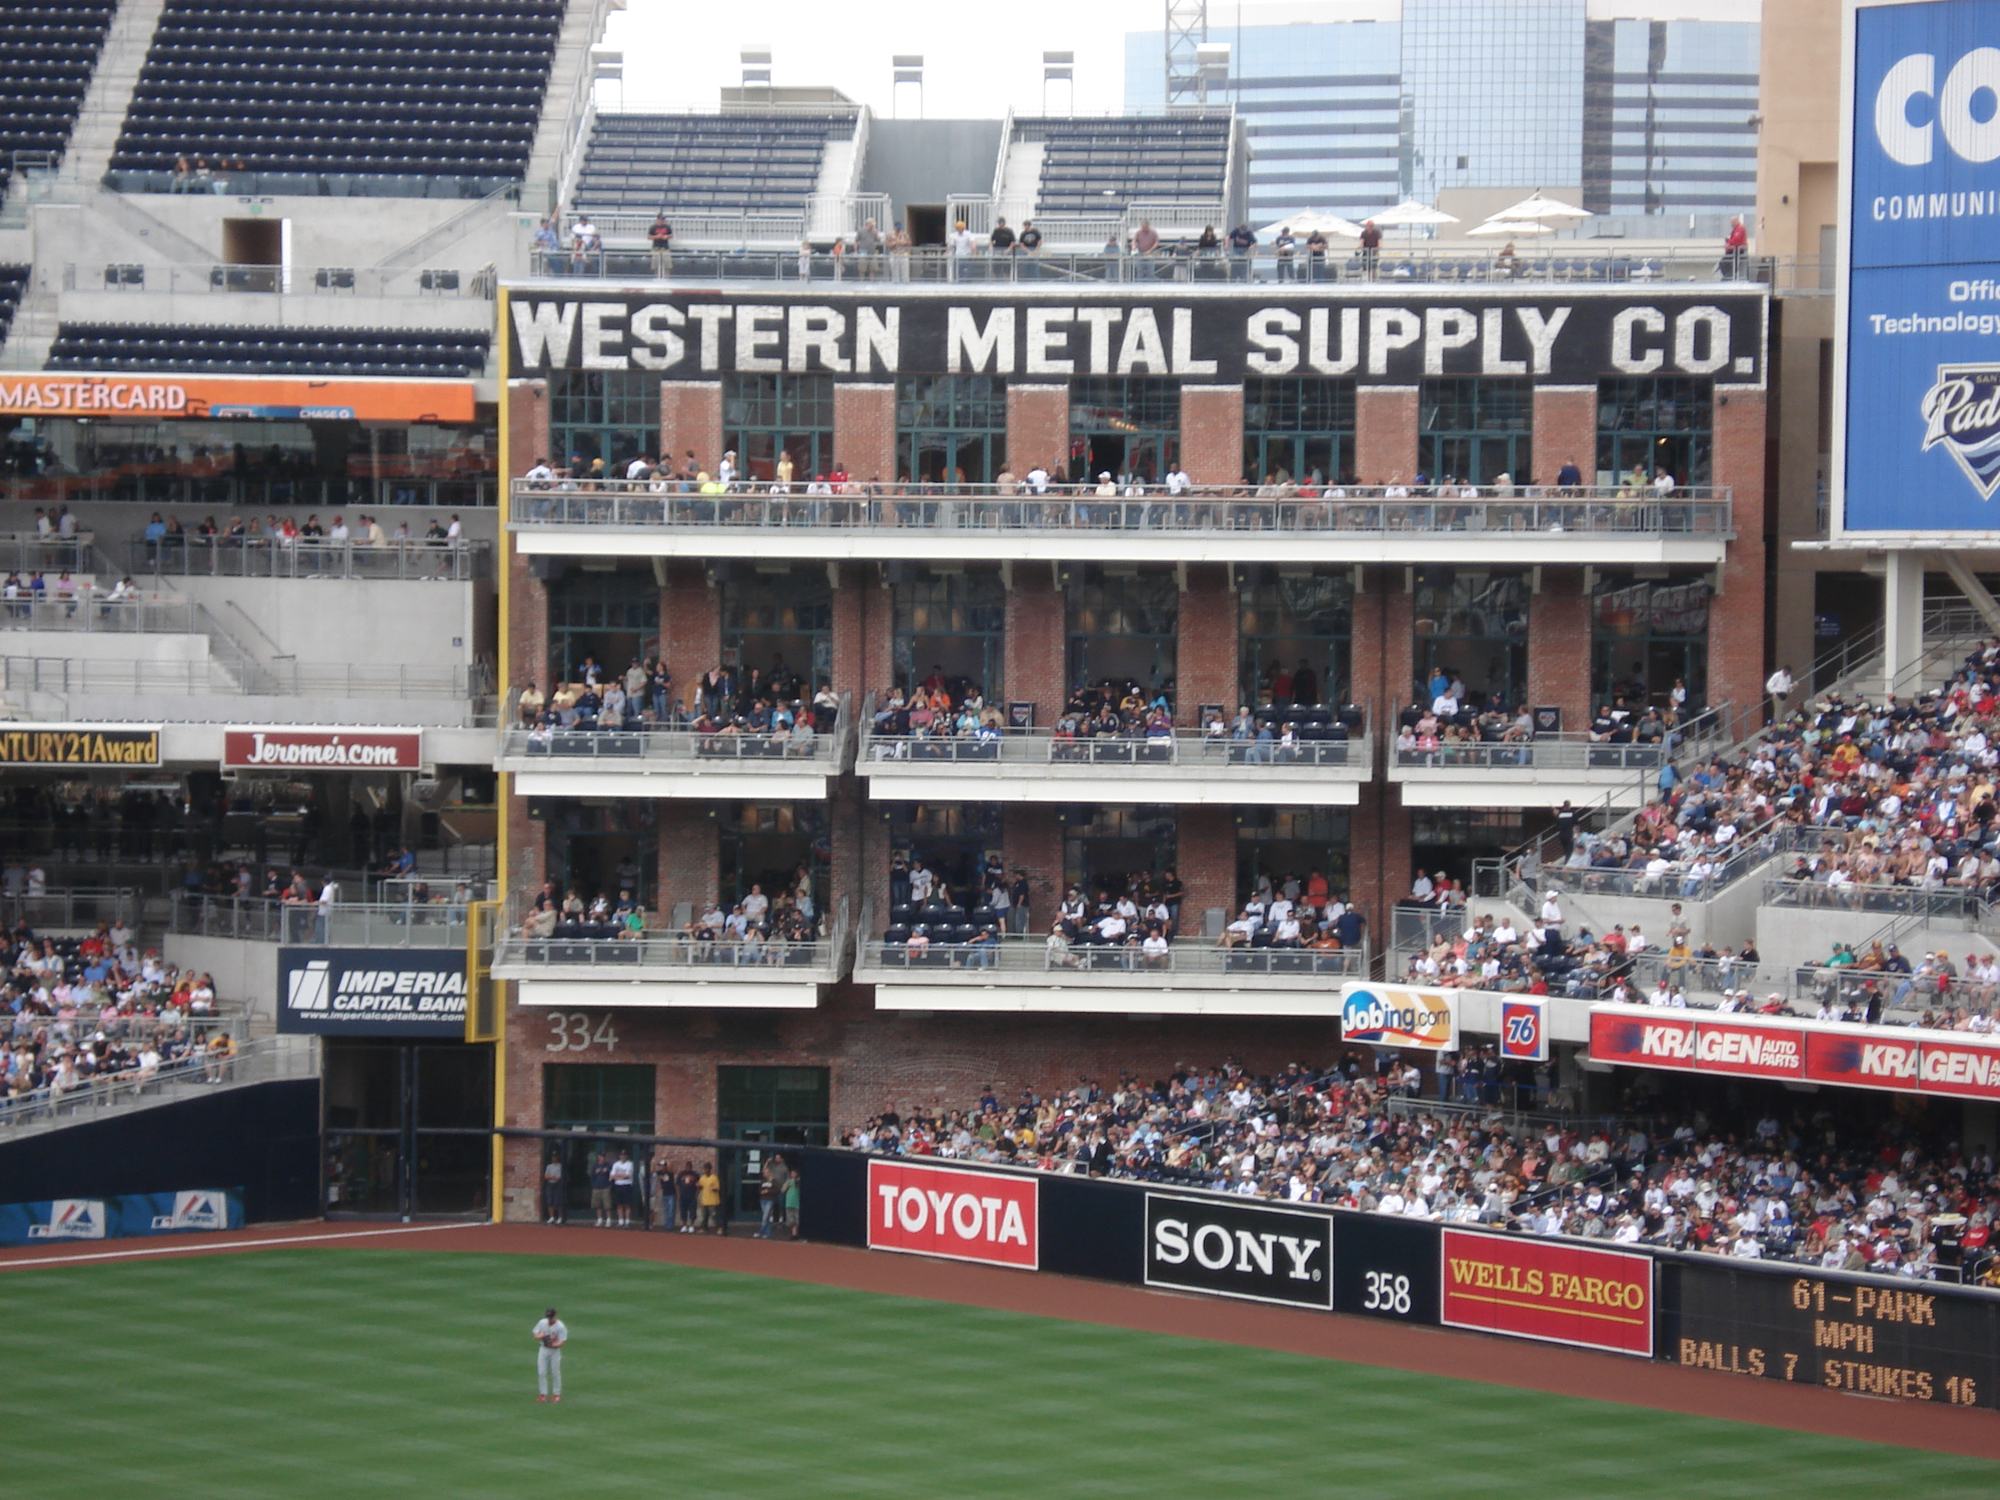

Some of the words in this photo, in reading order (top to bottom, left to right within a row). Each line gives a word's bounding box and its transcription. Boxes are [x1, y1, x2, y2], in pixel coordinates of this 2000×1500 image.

[1873, 190, 2000, 221] COMMUNI
[510, 301, 900, 373] WESTERN
[948, 307, 1217, 374] METAL
[1247, 307, 1572, 375] SUPPLY
[1611, 306, 1754, 374] CO.
[0, 383, 187, 410] MASTERCARD
[247, 733, 399, 765] Jerome's.com
[337, 971, 467, 994] IMPERIA
[333, 995, 413, 1010] CAPITAL
[1343, 1001, 1451, 1033] Jobing.com
[545, 1012, 619, 1052] 334
[1507, 1014, 1536, 1045] 76
[1641, 1026, 1763, 1065] KRAGEN
[1762, 1039, 1797, 1054] AUTO
[1759, 1052, 1800, 1068] PARTS
[1860, 1044, 1991, 1086] KRAGEN
[879, 1185, 1028, 1246] TOYOTA
[1363, 1271, 1411, 1314] 358
[1449, 1258, 1545, 1296] WELLS
[1550, 1272, 1645, 1310] FARGO
[1815, 1319, 1874, 1353] MPH
[1680, 1338, 1766, 1377] BALLS
[1784, 1353, 1799, 1381] 7
[1824, 1360, 1934, 1400] STRIKES
[1945, 1376, 1977, 1406] 16
